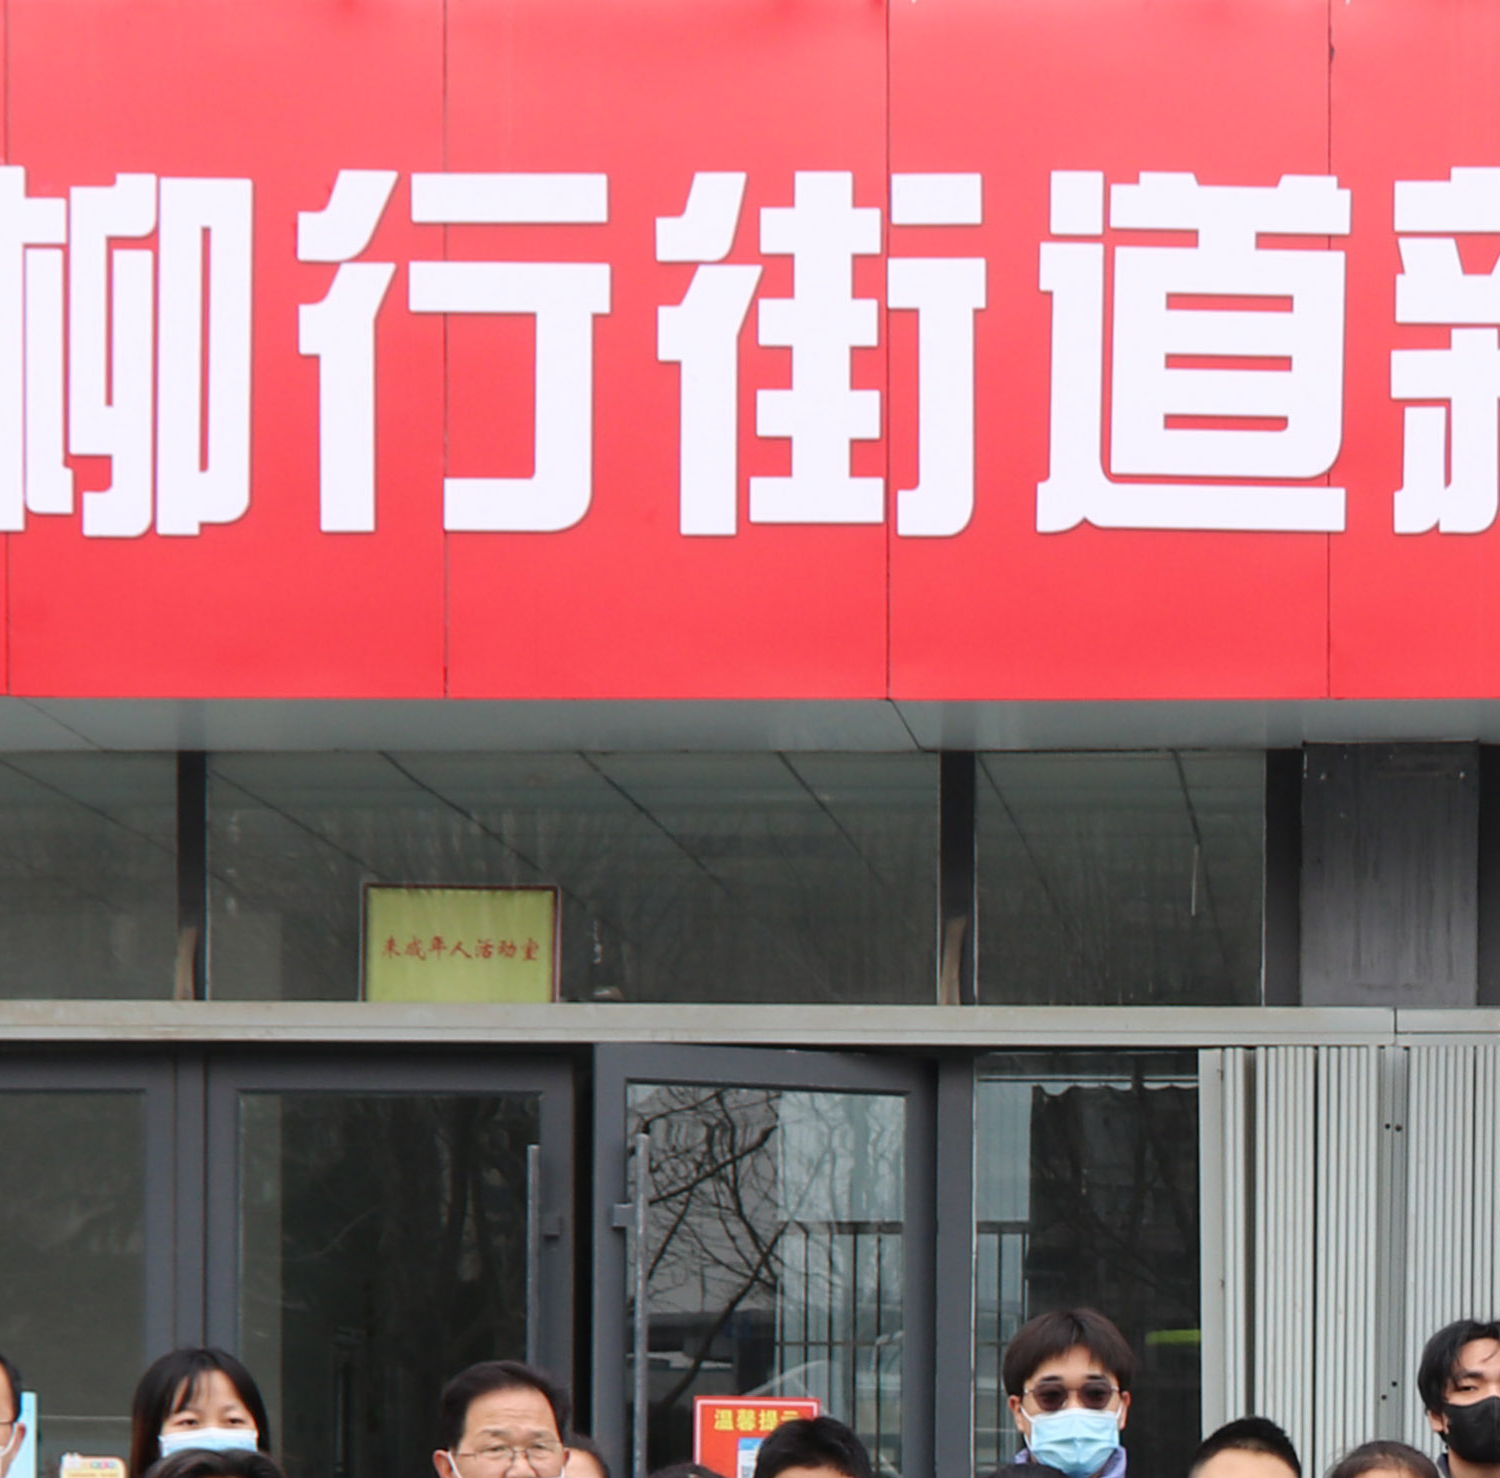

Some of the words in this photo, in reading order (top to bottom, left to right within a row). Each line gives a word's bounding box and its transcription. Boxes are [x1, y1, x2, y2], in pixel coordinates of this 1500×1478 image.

[382, 935, 540, 961] 未成年人活动室
